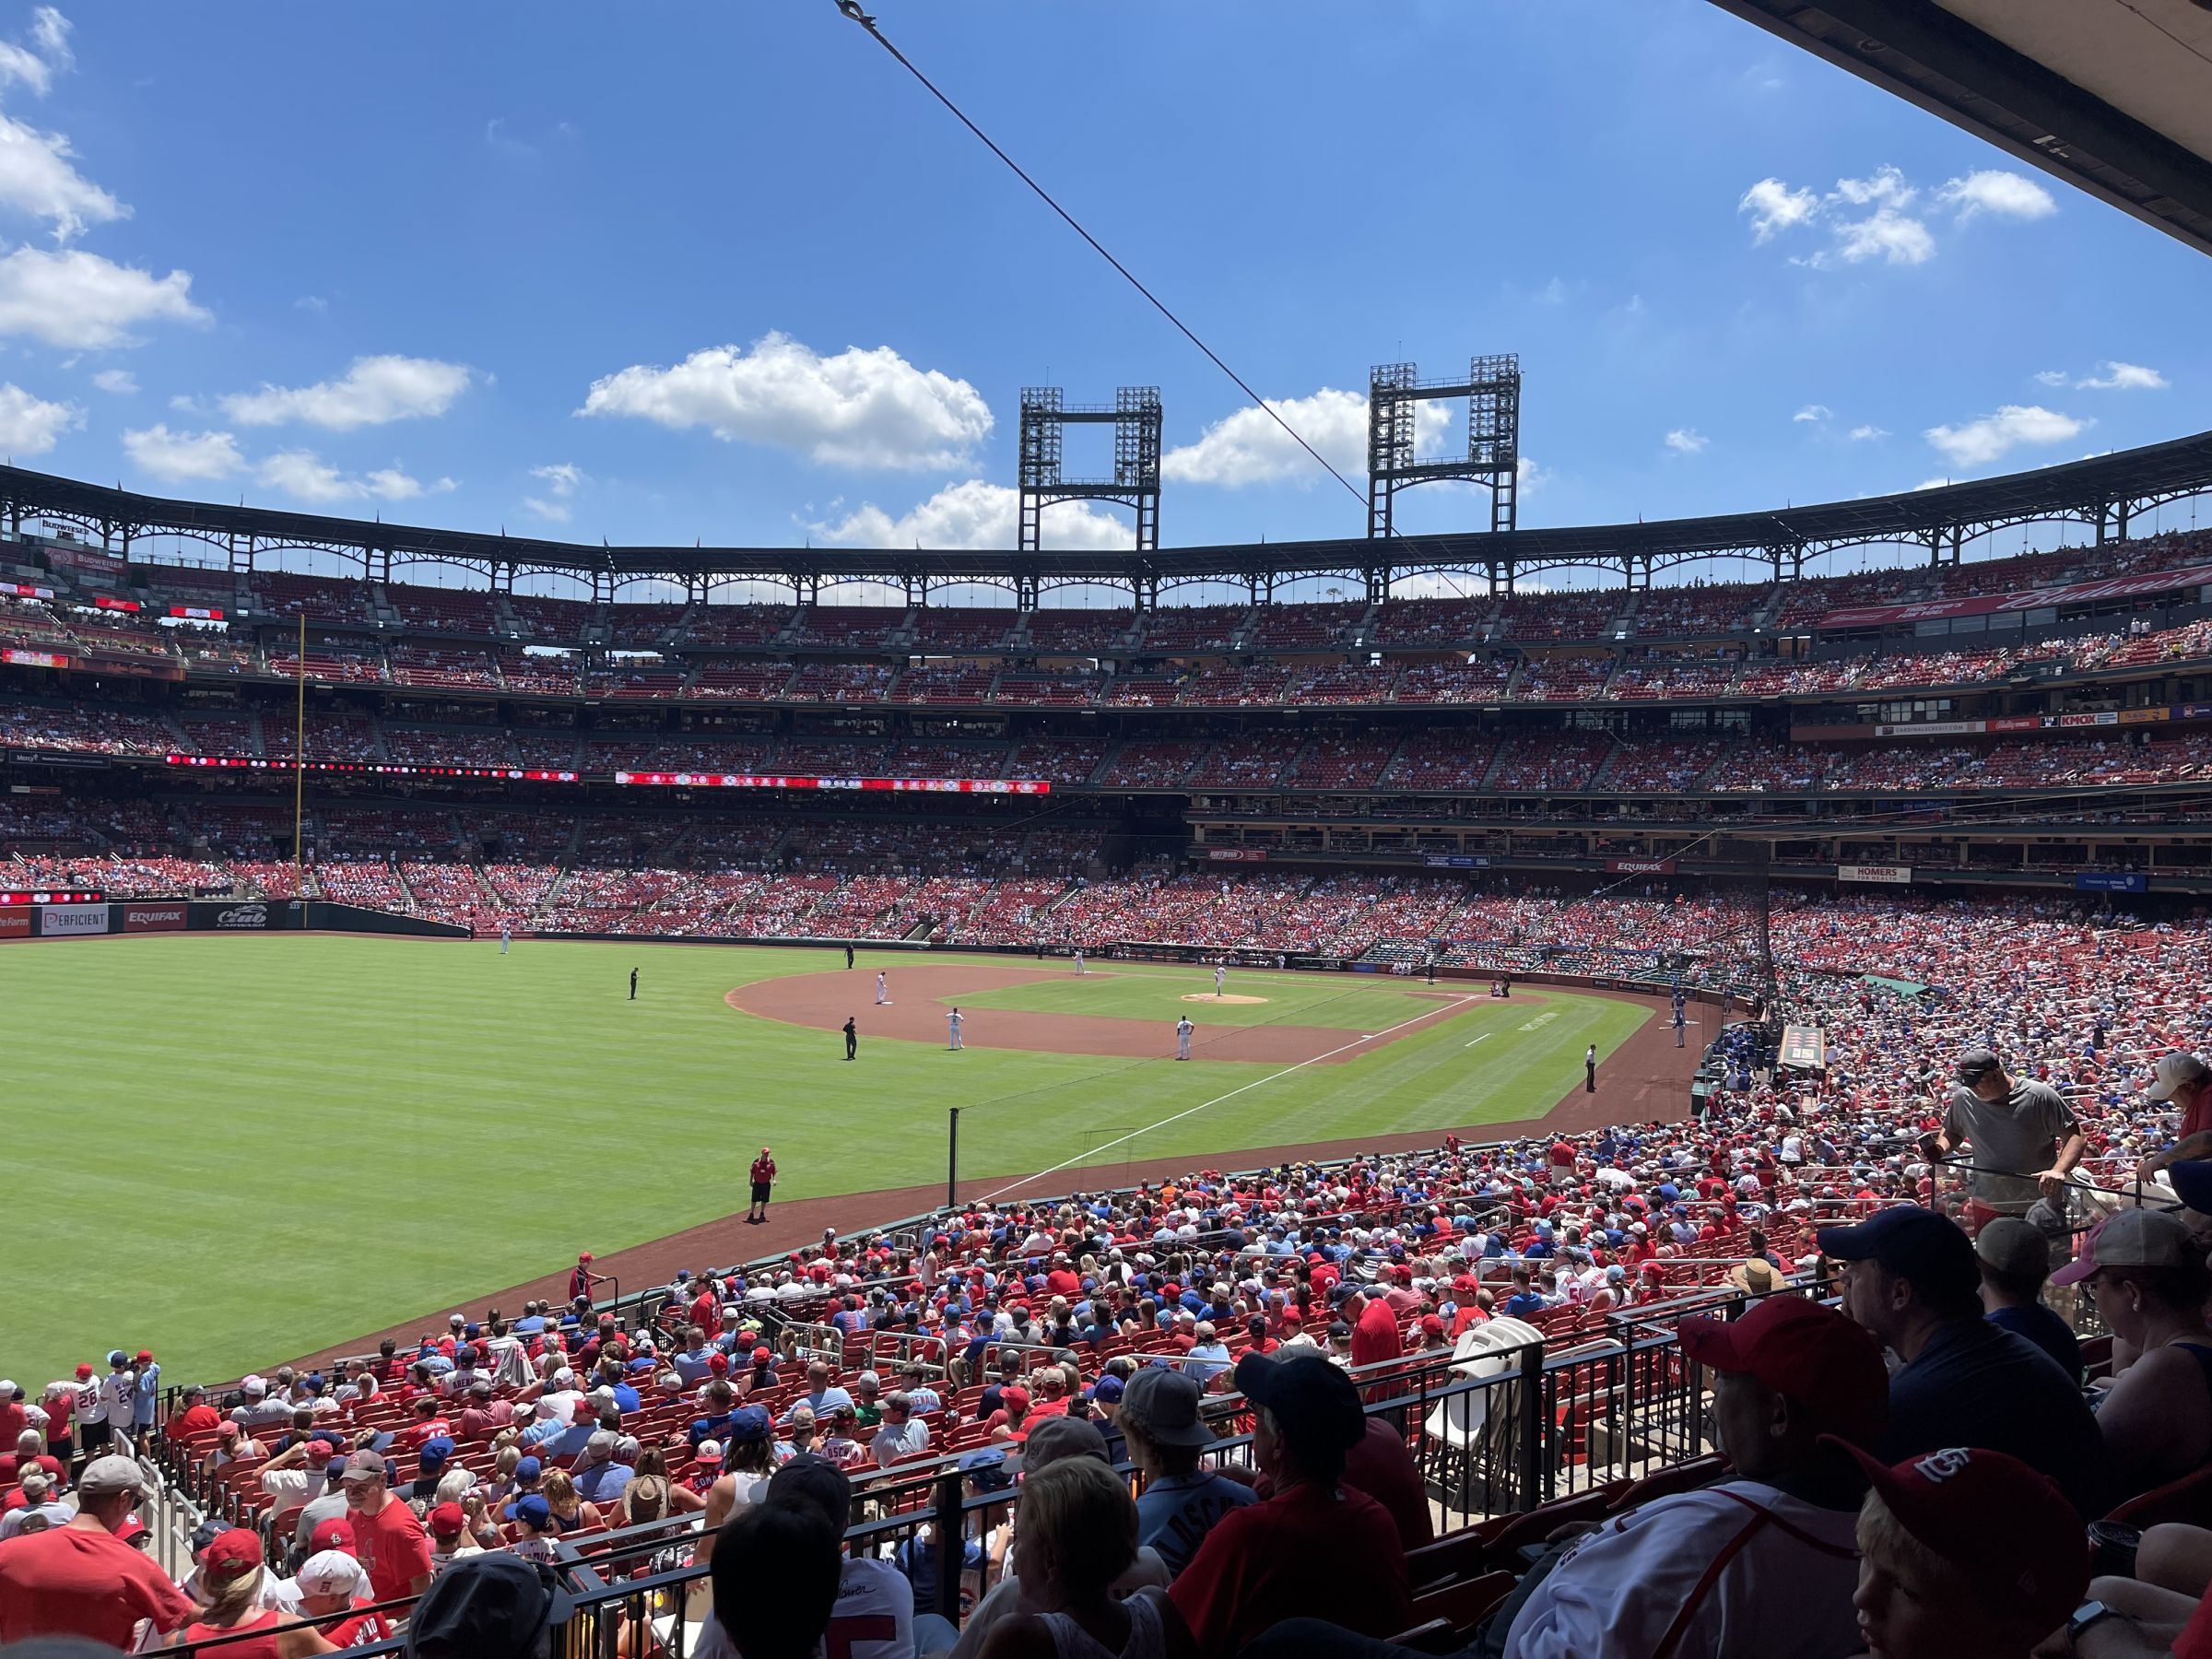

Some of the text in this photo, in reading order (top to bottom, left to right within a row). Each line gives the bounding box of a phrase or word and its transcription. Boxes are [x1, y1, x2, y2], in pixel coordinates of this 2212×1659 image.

[42, 519, 89, 535] BUDWEISER
[77, 554, 124, 569] BUDWEISER
[2061, 714, 2096, 726] KMOX
[1895, 724, 1964, 733] CARDINALSCREDIT.COM
[1618, 862, 1663, 873] EQUIFAX
[1857, 867, 1898, 876] HOMERS
[44, 912, 106, 928] PERFICIENT
[129, 911, 182, 924] EQUIFAX
[77, 1391, 98, 1404] 28
[118, 1384, 134, 1404] 24
